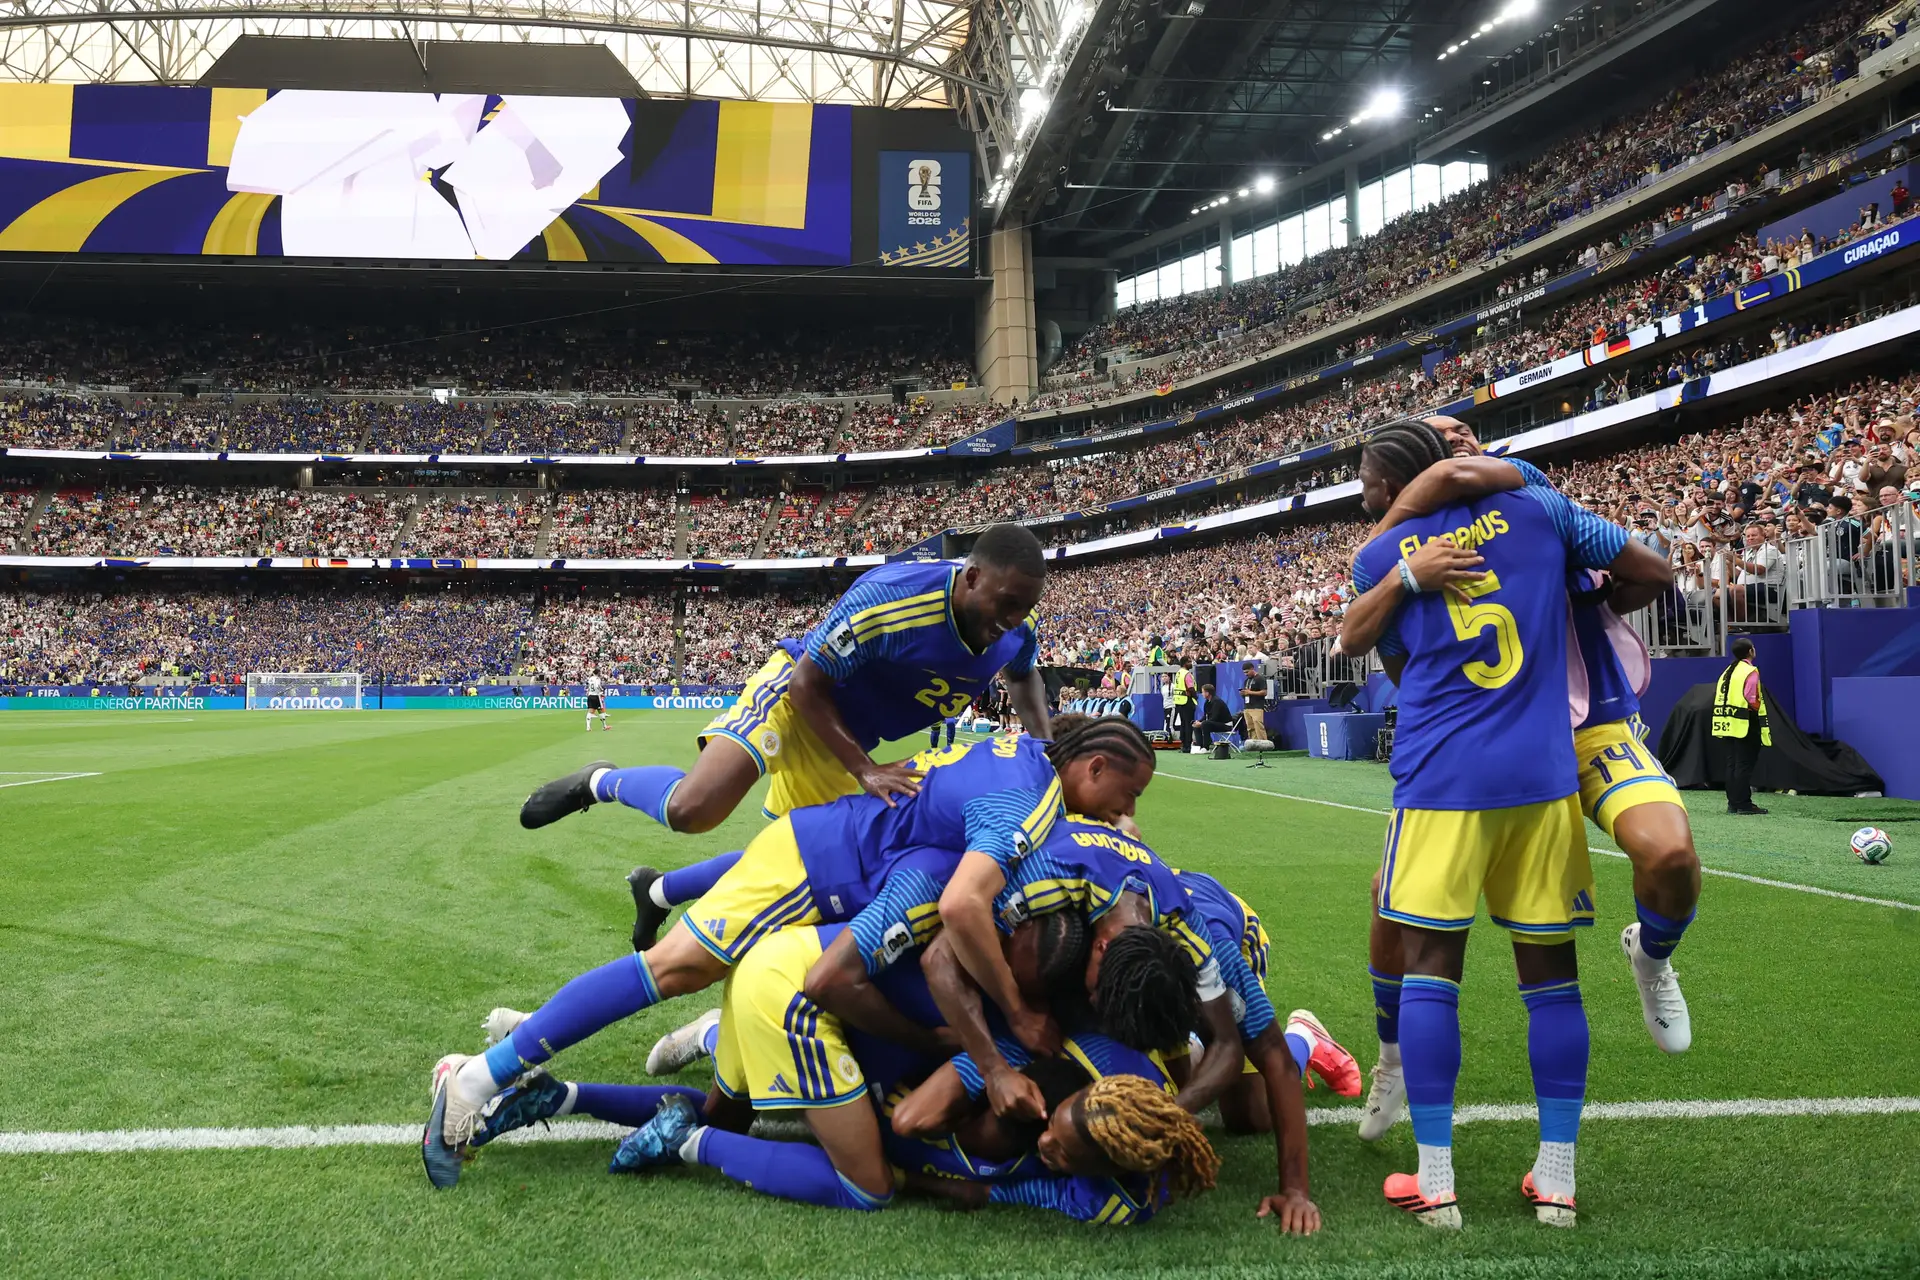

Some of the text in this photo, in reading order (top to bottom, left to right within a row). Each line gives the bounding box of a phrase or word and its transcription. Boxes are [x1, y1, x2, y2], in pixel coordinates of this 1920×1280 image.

[1477, 288, 1546, 321] FIFA WORLD CUP 2026
[1519, 231, 1900, 385] GERMANY 1 1 CURAÇAO
[1222, 396, 1254, 410] HOUSTON
[1146, 488, 1176, 501] HOUSTON
[1440, 569, 1524, 689] 5
[38, 689, 60, 697] FIFA
[605, 688, 620, 696] IFA
[914, 678, 972, 717] 23
[94, 698, 140, 709] ENERGY
[145, 697, 203, 709] PARTNER
[270, 696, 343, 709] aramco
[485, 697, 529, 709] ENERGY
[533, 697, 588, 709] PARTNER
[653, 696, 724, 709] aramco
[1589, 742, 1644, 784] 14
[1070, 832, 1152, 865] BACUNA
